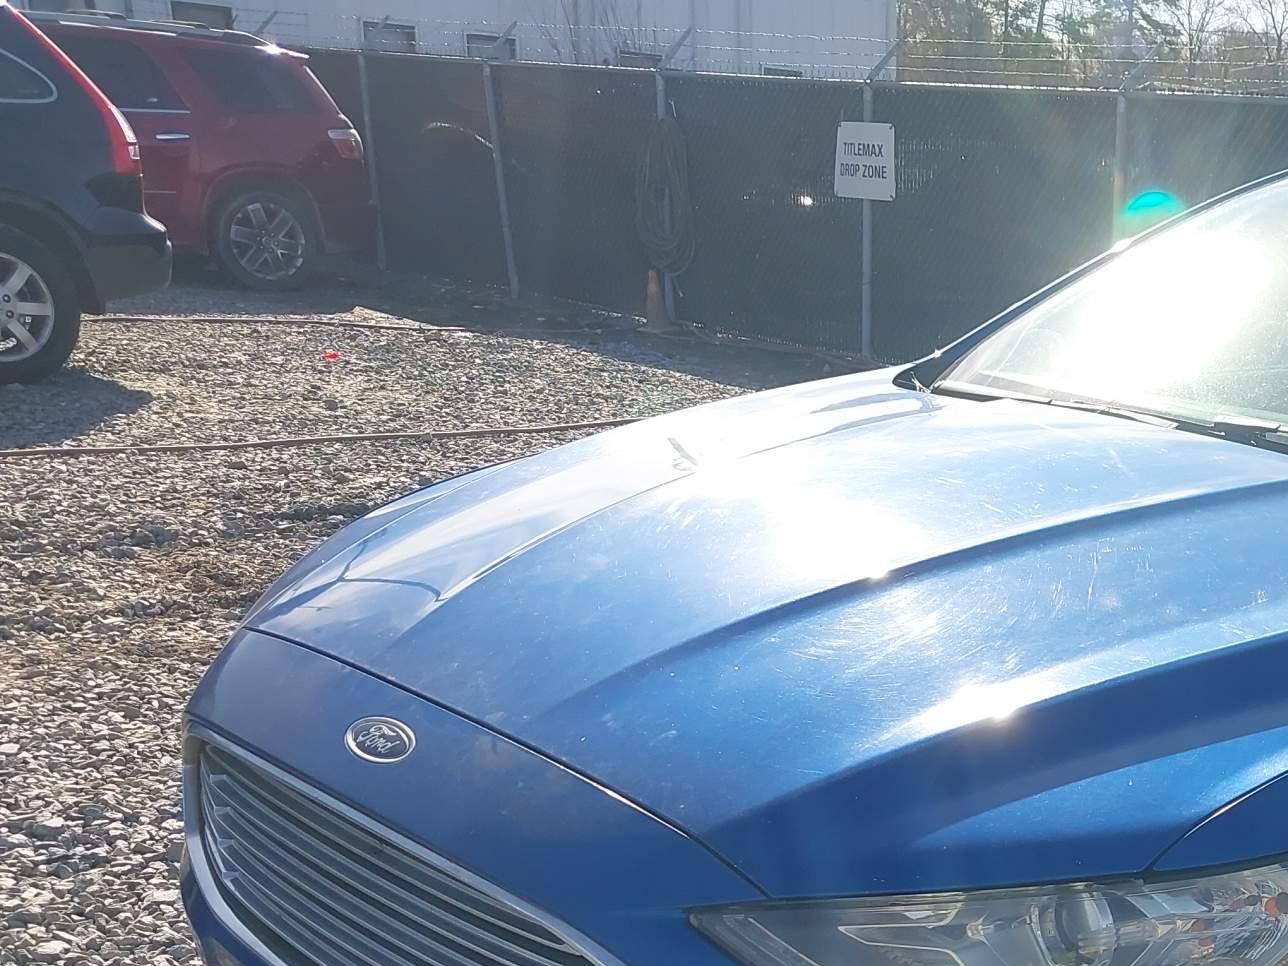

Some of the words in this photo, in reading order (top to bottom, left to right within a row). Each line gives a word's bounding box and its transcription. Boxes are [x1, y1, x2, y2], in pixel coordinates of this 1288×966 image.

[843, 142, 884, 158] TITLEMAX
[840, 162, 860, 177] DROP
[862, 164, 888, 180] ZONE
[356, 725, 401, 754] Ford
